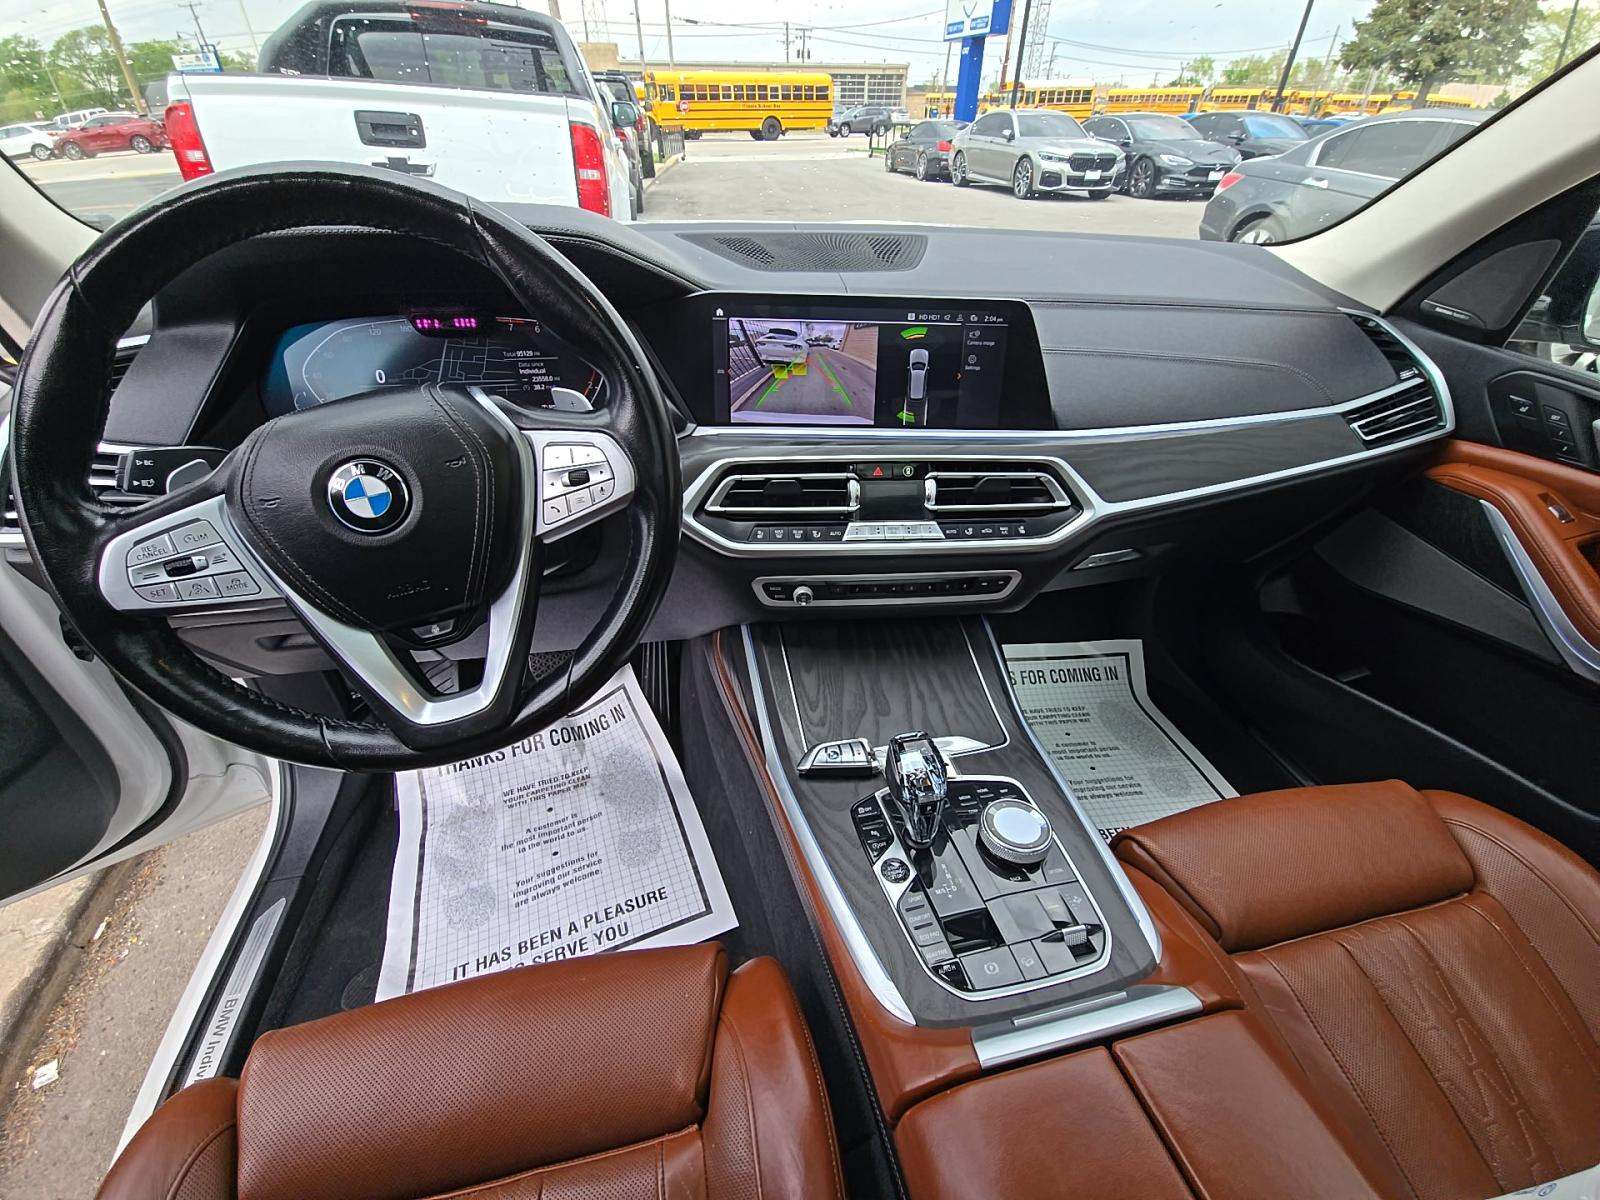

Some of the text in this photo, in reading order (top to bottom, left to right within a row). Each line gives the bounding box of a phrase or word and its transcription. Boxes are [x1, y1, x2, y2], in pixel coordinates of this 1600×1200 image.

[508, 324, 513, 332] 7
[534, 326, 540, 334] 6
[375, 369, 386, 384] 0
[331, 464, 394, 494] BMW
[193, 532, 208, 543] LIM
[136, 548, 168, 561] CANCEL
[150, 588, 168, 598] SET
[226, 582, 248, 592] MODE
[1020, 670, 1047, 686] FOR
[1050, 666, 1101, 684] COMING
[1104, 666, 1119, 680] IN
[511, 734, 546, 758] FOR
[550, 714, 610, 747] COMING
[610, 704, 626, 724] IN
[502, 789, 514, 798] WE
[517, 783, 536, 794] HAVE
[538, 776, 558, 787] TRIED
[572, 766, 588, 777] KEEP
[503, 774, 590, 804] YOUR CARPETING CLEAN
[508, 800, 528, 810] WITH
[530, 794, 546, 803] THIS
[548, 786, 571, 797] PAPER
[501, 812, 602, 852] the most important person
[534, 816, 568, 832] customer
[1098, 826, 1130, 840] BE
[528, 841, 540, 850] the
[543, 833, 566, 845] world
[512, 858, 603, 898] improving our service
[516, 850, 598, 888] Your suggestions for
[514, 898, 529, 908] are
[532, 884, 561, 902] always
[452, 886, 668, 980] IT HAS BEEN A PLEASURE
[593, 922, 630, 946] YOU
[212, 998, 238, 1036] BMW
